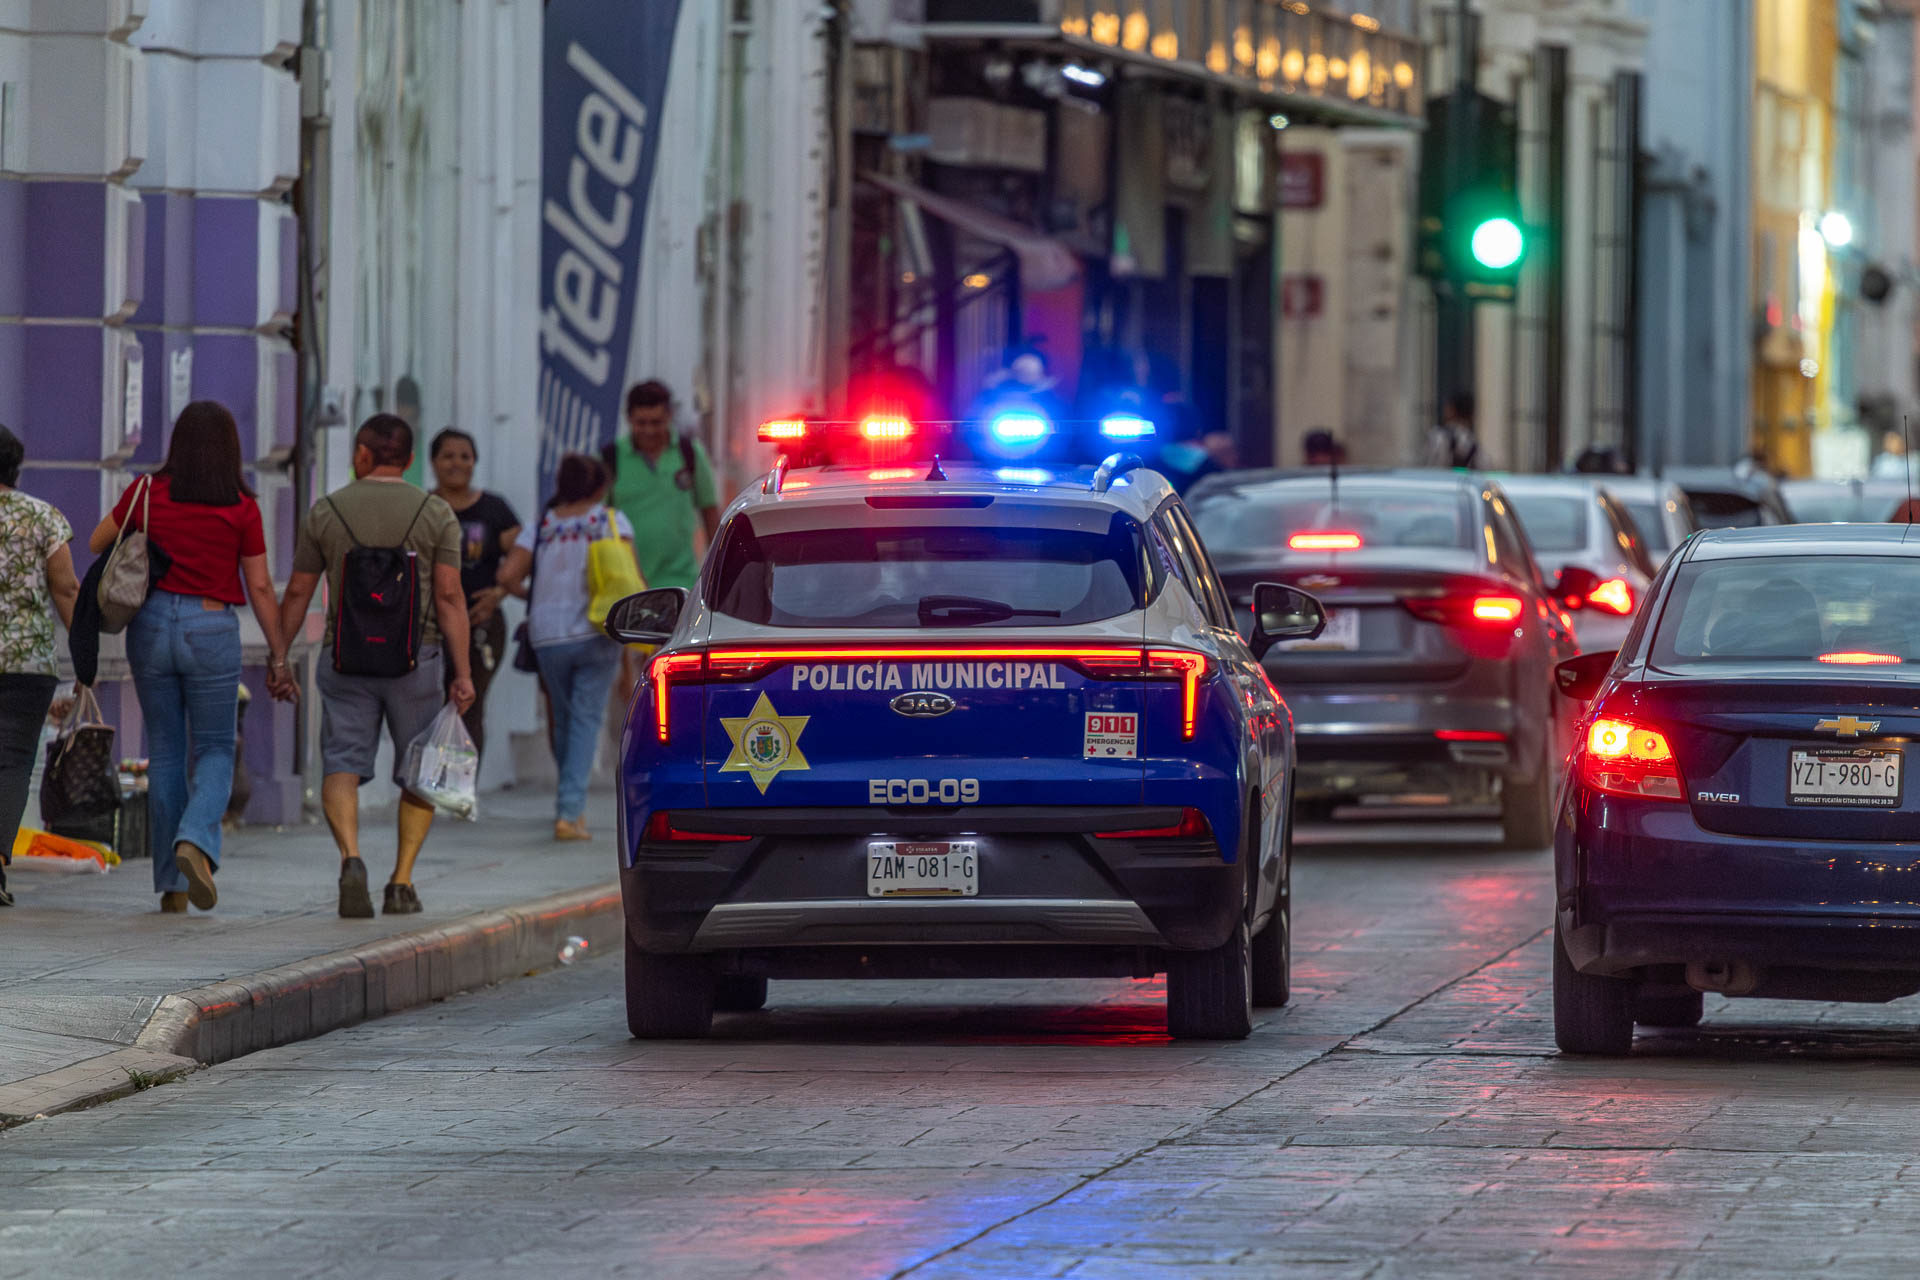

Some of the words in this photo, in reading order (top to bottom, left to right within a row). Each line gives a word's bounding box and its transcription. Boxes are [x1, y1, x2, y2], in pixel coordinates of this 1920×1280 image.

[540, 41, 648, 386] telcel
[791, 660, 903, 691] POLICÍA
[911, 662, 1066, 689] MUNICIPAL
[1091, 718, 1132, 732] 911
[1793, 762, 1896, 788] YZT-980-G
[868, 778, 980, 804] ECO-09
[1697, 791, 1741, 804] AVEO
[872, 856, 974, 879] ZAM-081-G
